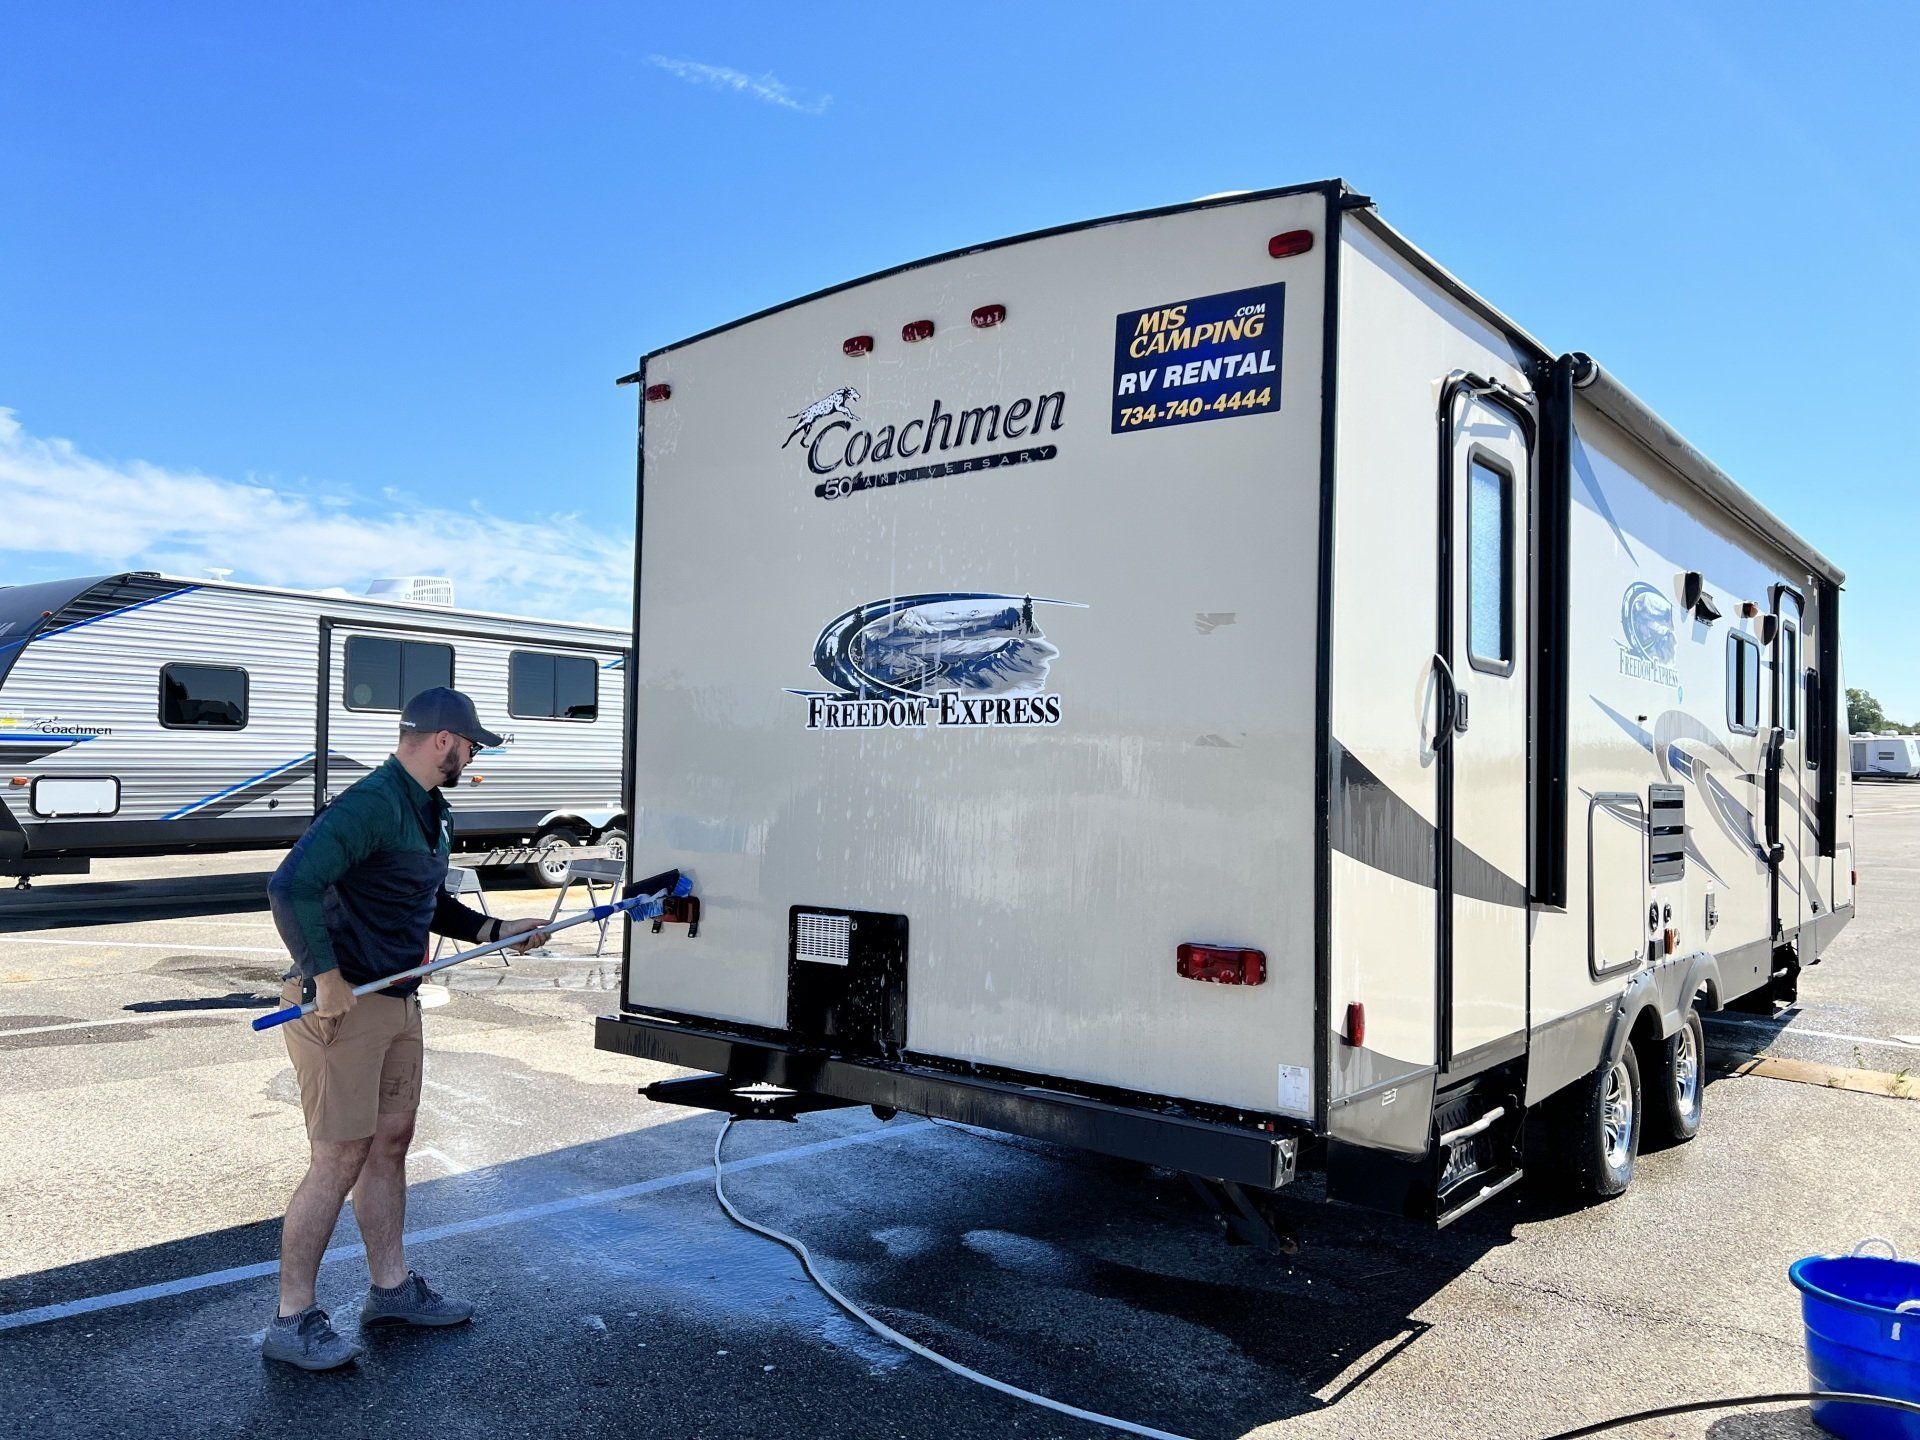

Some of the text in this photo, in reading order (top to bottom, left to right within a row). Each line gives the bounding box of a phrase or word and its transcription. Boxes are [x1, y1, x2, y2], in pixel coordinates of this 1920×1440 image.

[1134, 305, 1188, 337] MIS
[1234, 303, 1266, 318] .COM
[1129, 314, 1265, 359] CAMPING
[1118, 349, 1277, 395] RV RENTAL
[1120, 387, 1271, 427] 734-740-4444
[807, 391, 1067, 474] Coachmen
[864, 448, 1050, 489] ANNIVERSARY
[42, 724, 112, 735] Coachmen
[806, 691, 1061, 729] FREEDOM EXPRESS
